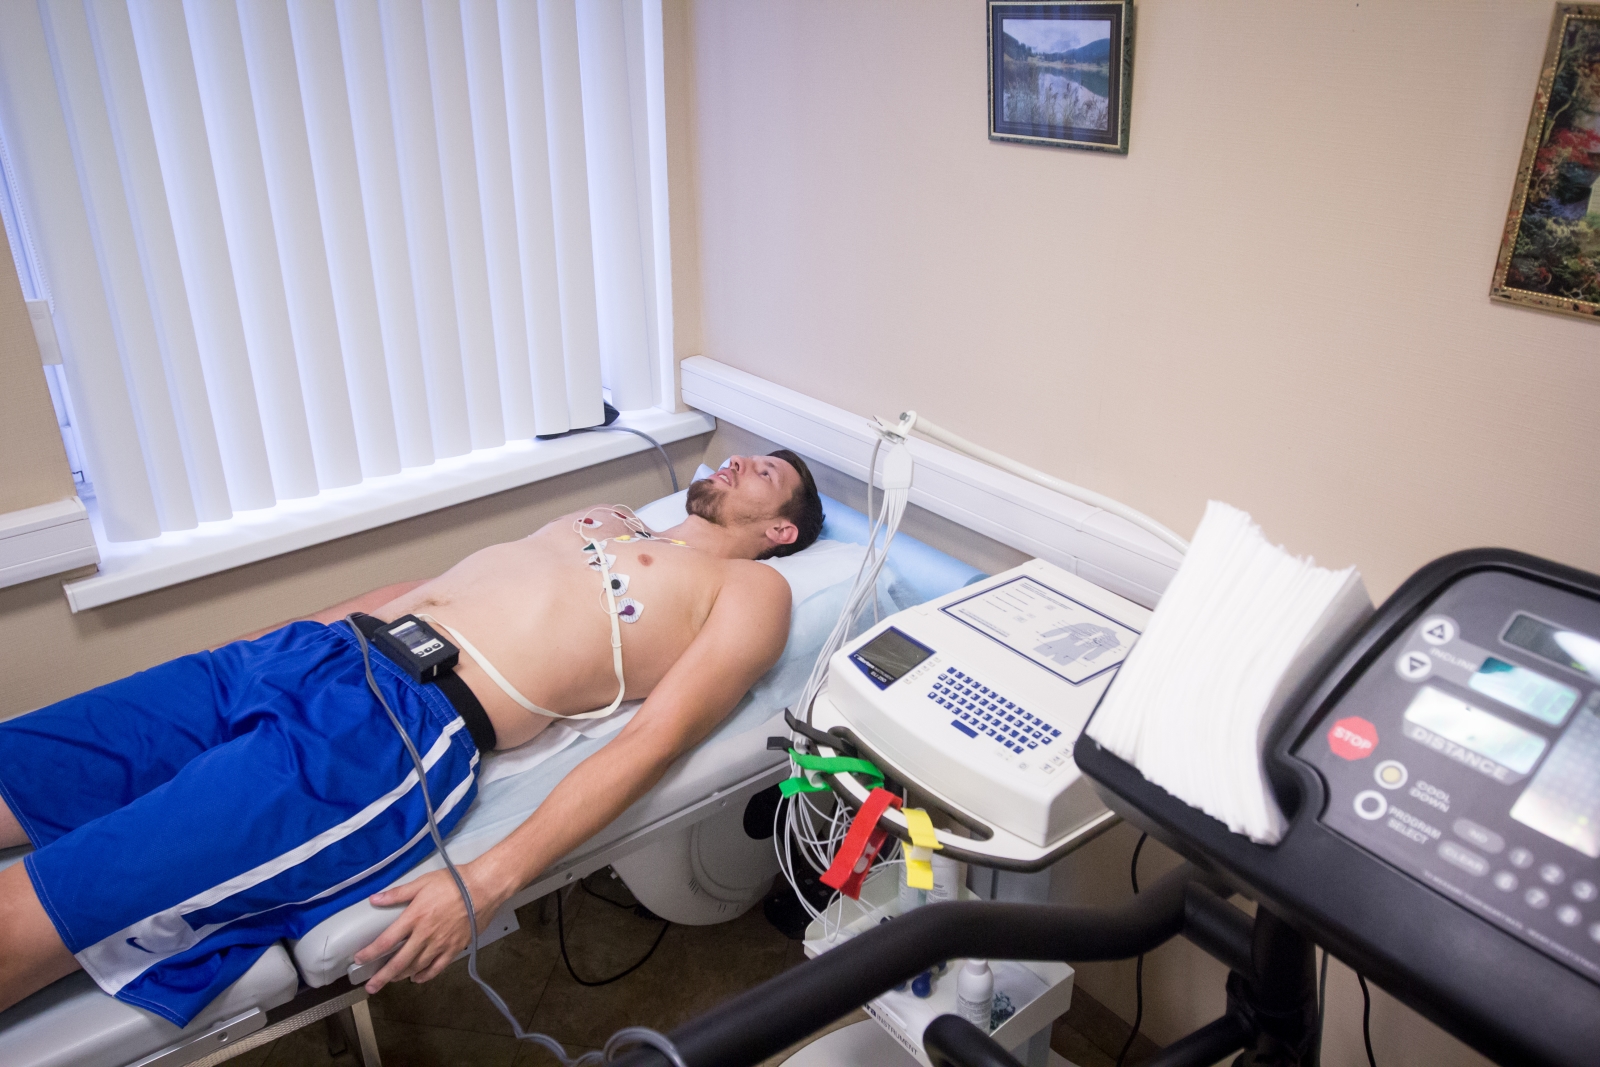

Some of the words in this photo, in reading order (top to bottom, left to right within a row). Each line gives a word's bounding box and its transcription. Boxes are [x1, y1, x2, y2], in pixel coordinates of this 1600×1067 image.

[1333, 726, 1373, 750] STOP
[1412, 726, 1509, 781] DISTANCE
[1408, 786, 1450, 813] DOWN
[1415, 780, 1451, 804] COOL
[1387, 817, 1429, 845] SELECT
[1388, 804, 1442, 839] PROGRAM
[876, 1014, 918, 1056] INSTRUMENT
